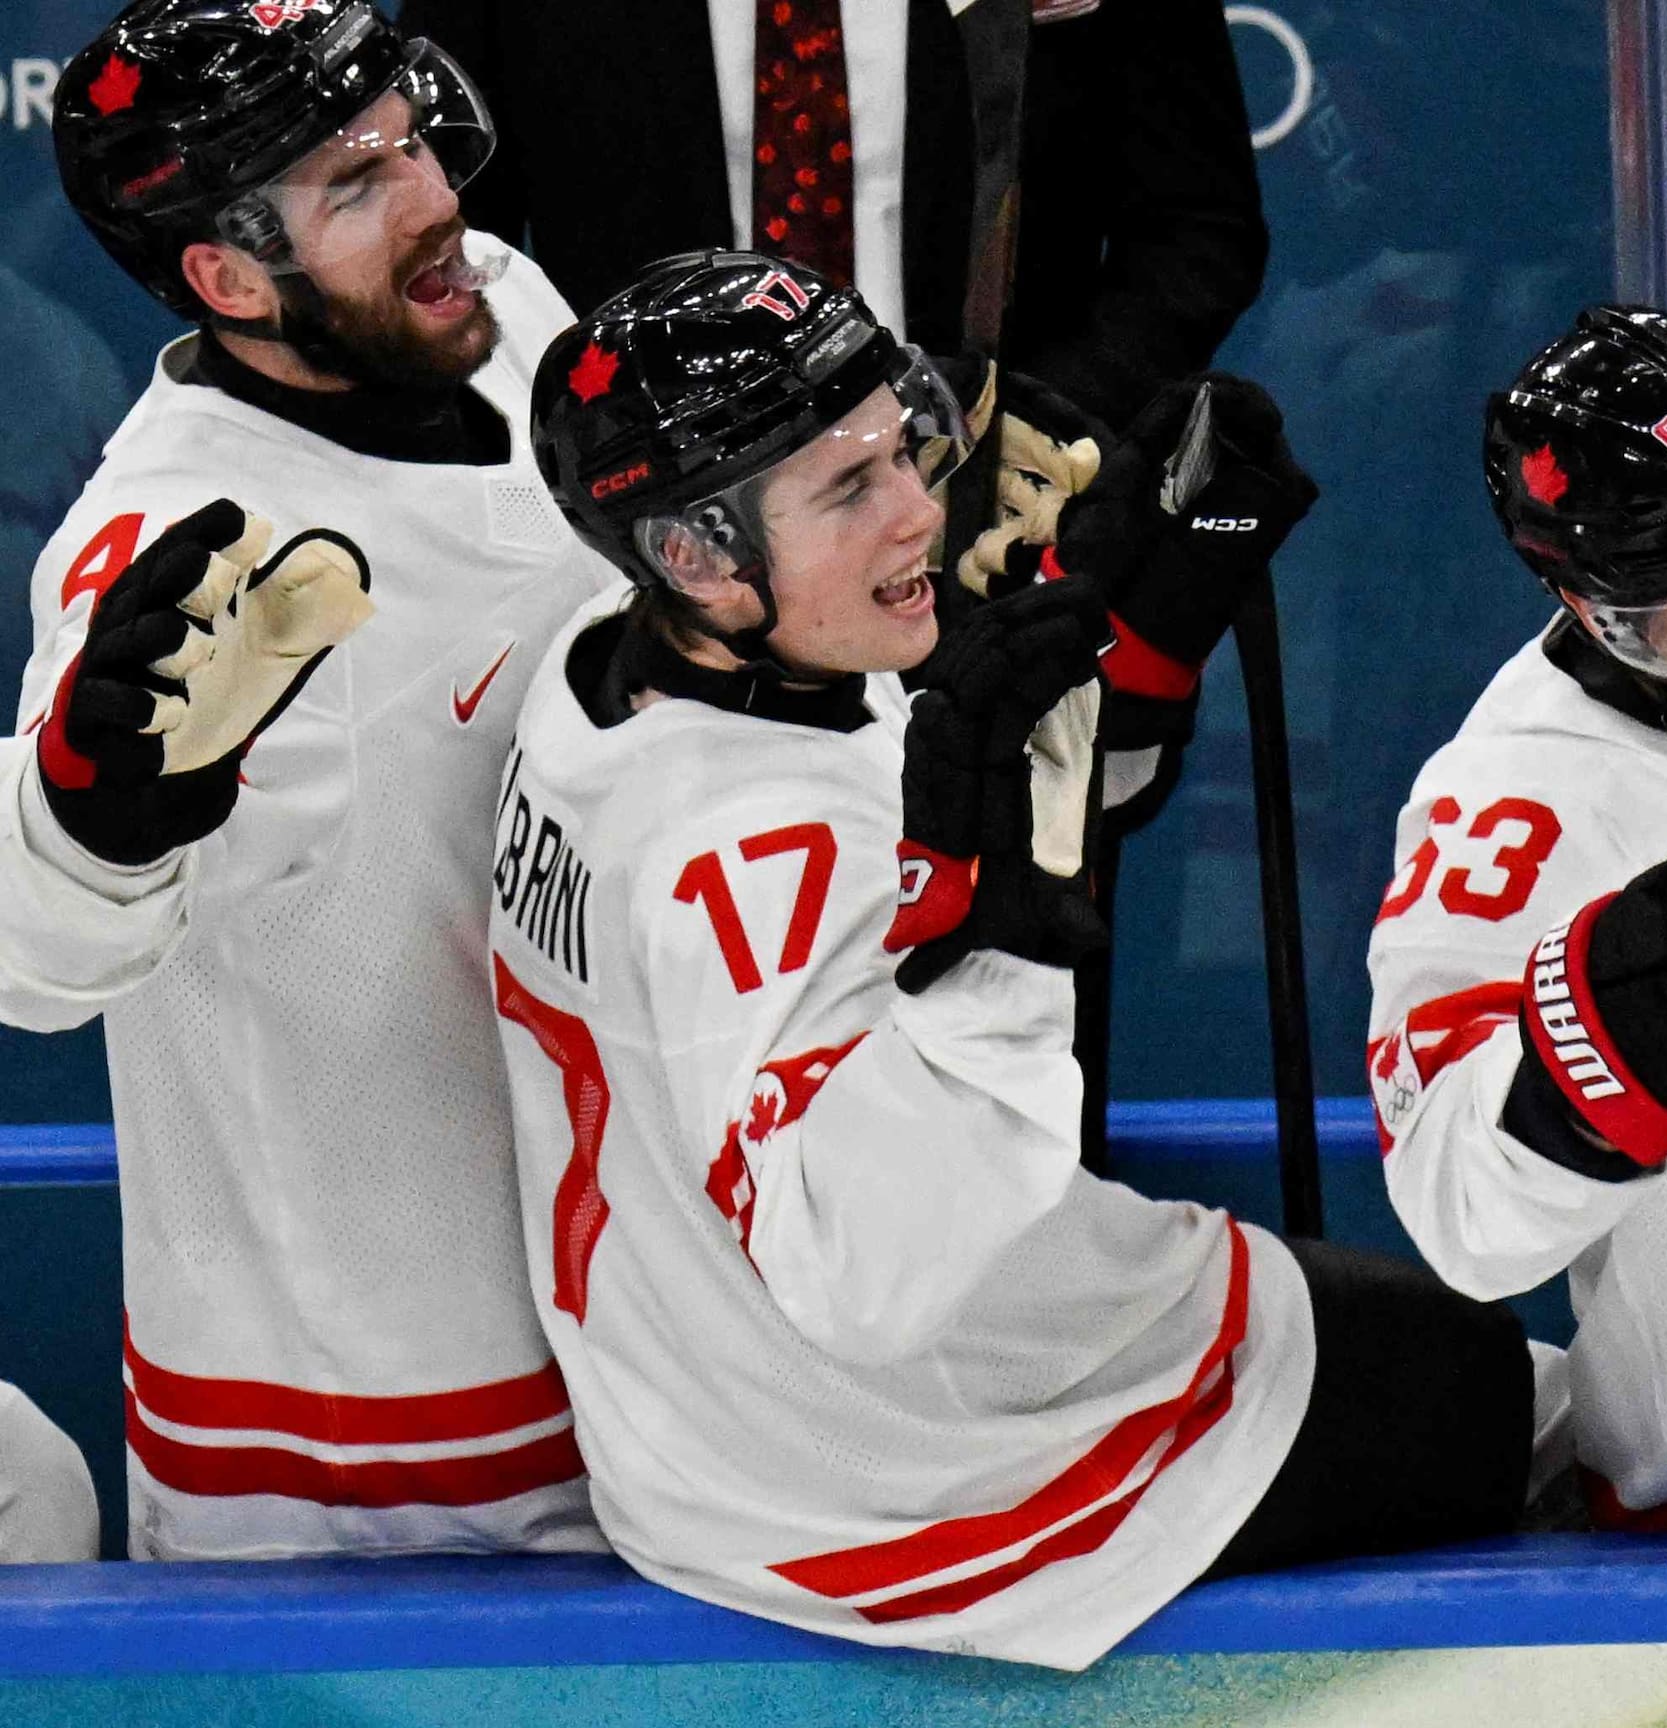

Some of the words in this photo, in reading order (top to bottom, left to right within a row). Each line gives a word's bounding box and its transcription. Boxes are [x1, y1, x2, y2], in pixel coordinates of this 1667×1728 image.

[743, 271, 810, 322] 17
[592, 463, 649, 498] CCM
[1192, 517, 1259, 531] CCM
[673, 822, 838, 994] 17
